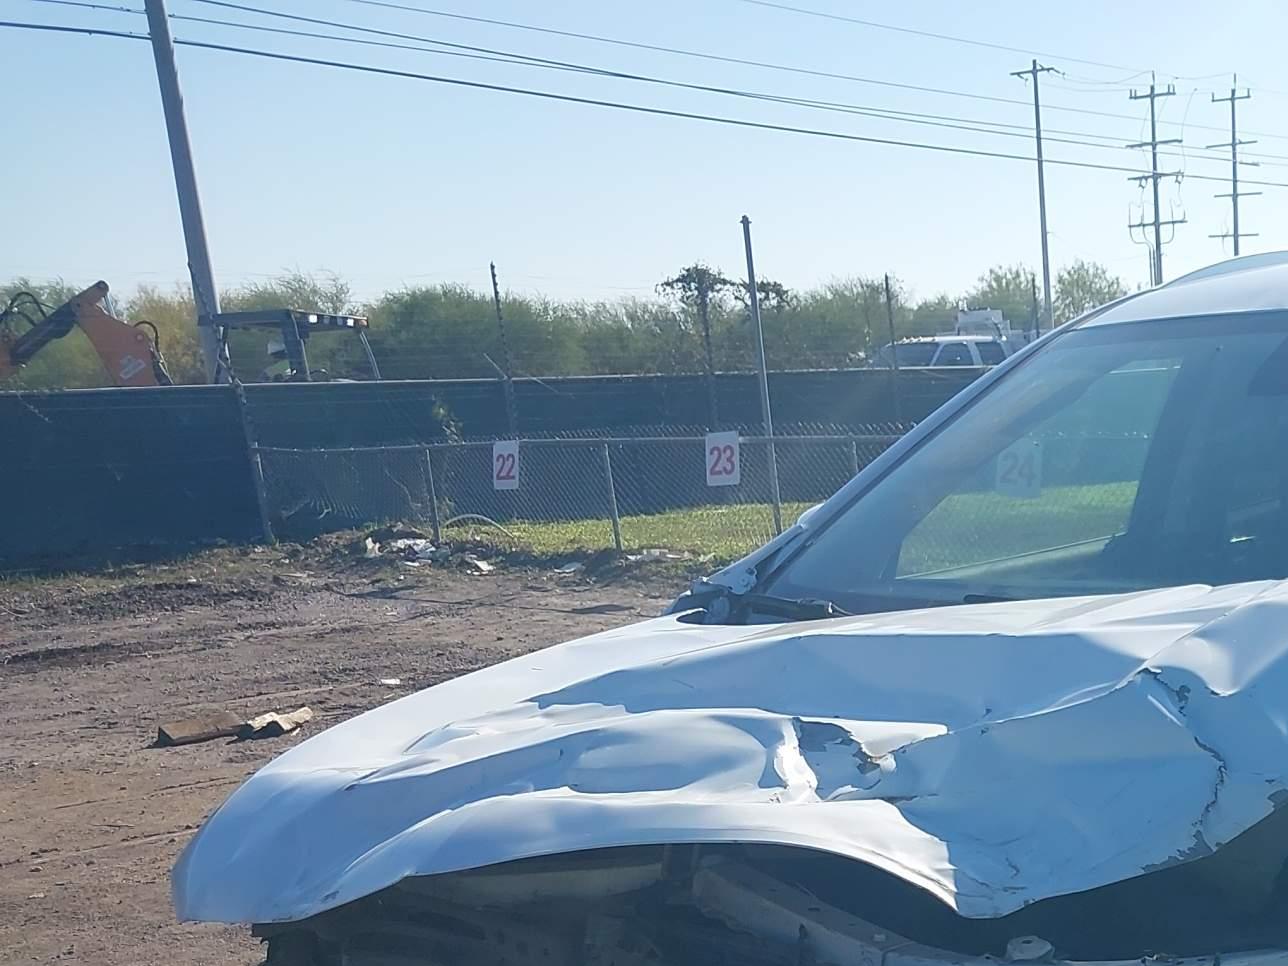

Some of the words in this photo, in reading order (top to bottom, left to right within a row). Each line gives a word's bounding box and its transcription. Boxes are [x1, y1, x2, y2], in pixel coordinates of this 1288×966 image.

[496, 454, 516, 480] 22
[710, 445, 736, 476] 23
[1000, 451, 1037, 488] 24
